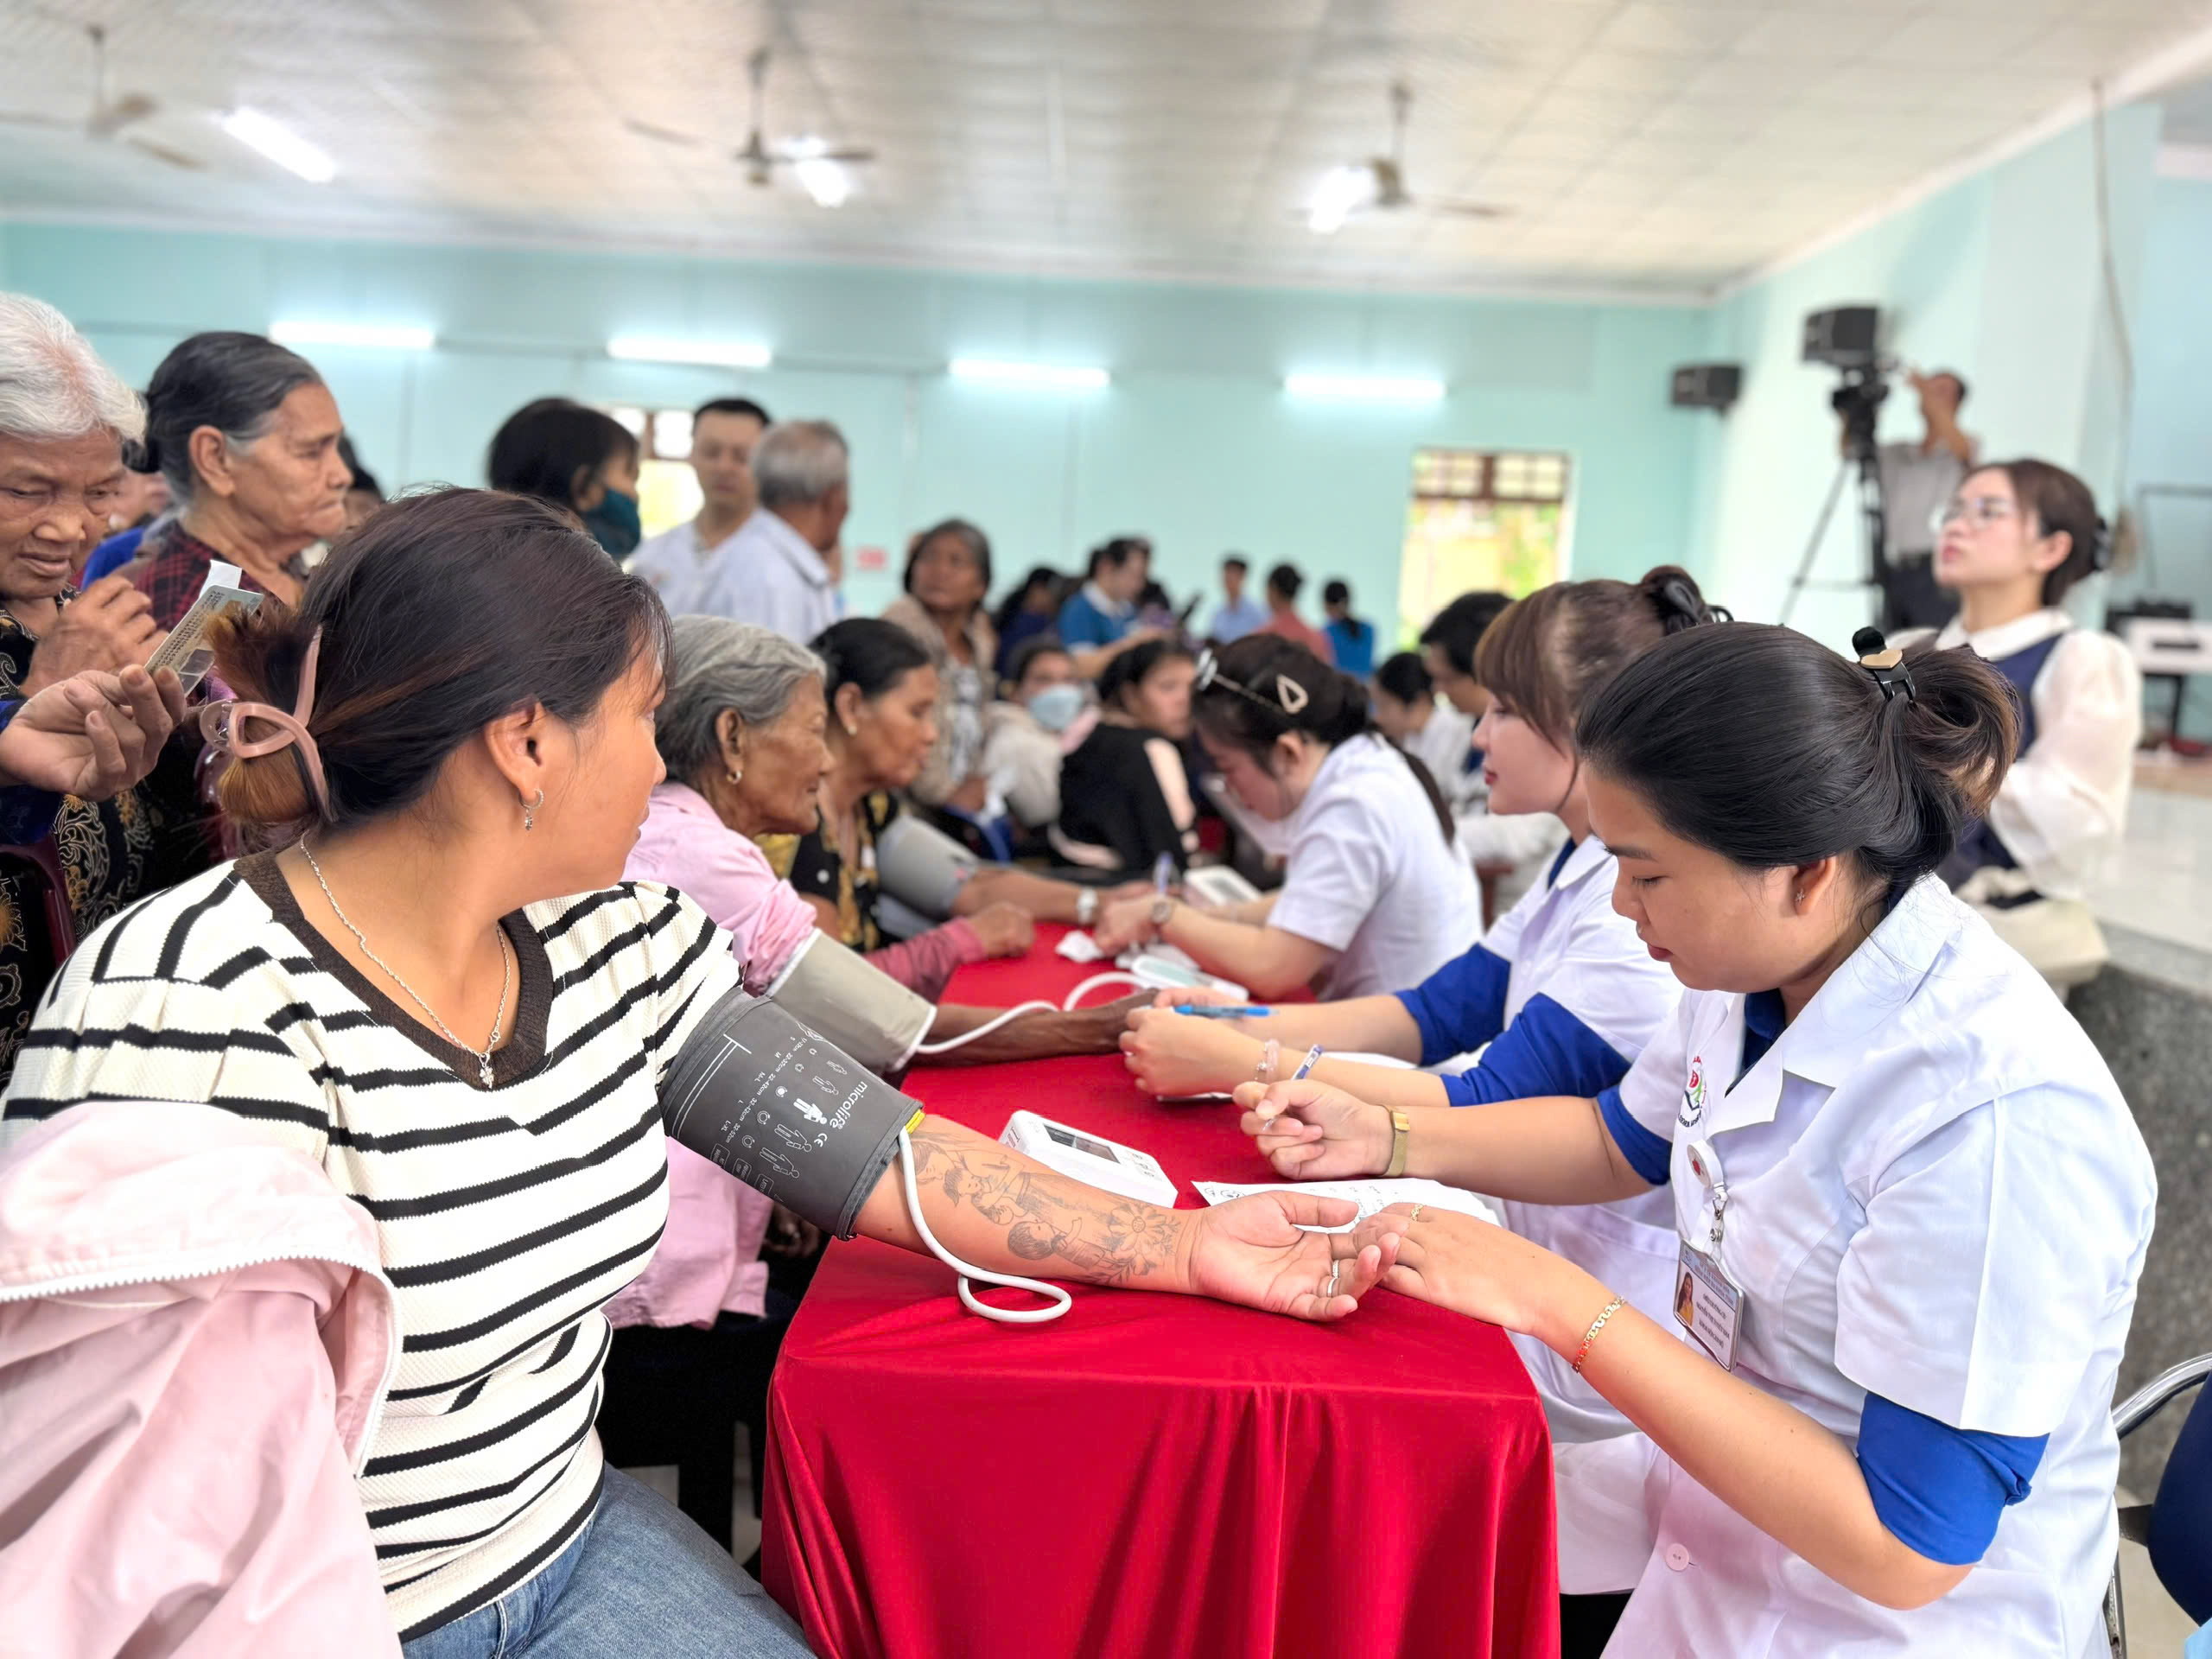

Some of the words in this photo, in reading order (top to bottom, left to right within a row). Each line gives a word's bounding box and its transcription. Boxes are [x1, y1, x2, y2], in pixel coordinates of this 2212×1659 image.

[756, 1073, 776, 1096] 22-42cm
[739, 1097, 758, 1122] 32-42cm
[830, 1081, 868, 1129] microlife
